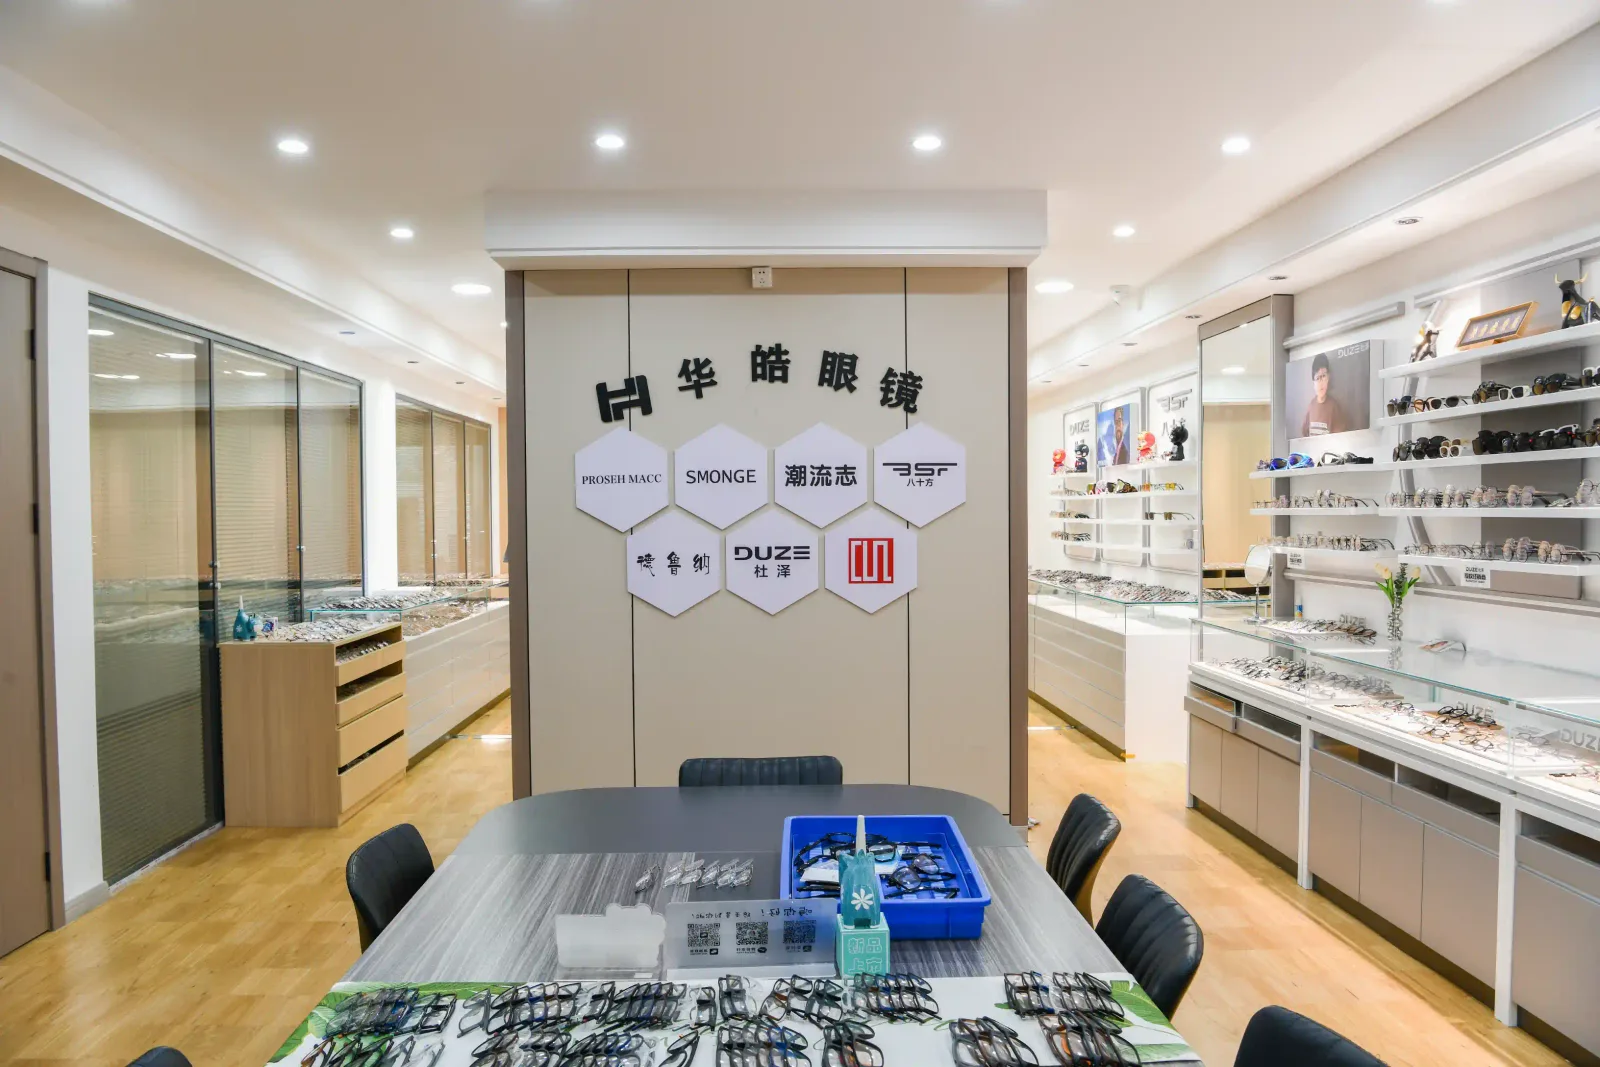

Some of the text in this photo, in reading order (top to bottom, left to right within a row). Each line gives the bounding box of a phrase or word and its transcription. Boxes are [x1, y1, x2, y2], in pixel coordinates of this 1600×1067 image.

[678, 343, 923, 414] 华皓眼镜
[582, 474, 662, 485] PROSEH MACC
[686, 469, 757, 484] SMONGE
[785, 464, 857, 487] 潮流志
[906, 478, 934, 487] 八十方
[734, 546, 810, 560] DUZE
[636, 551, 710, 577] 德鲁纳
[754, 564, 791, 578] 杜泽
[1560, 728, 1600, 752] DUZ
[848, 937, 882, 954] 新品
[848, 957, 882, 974] 上市
